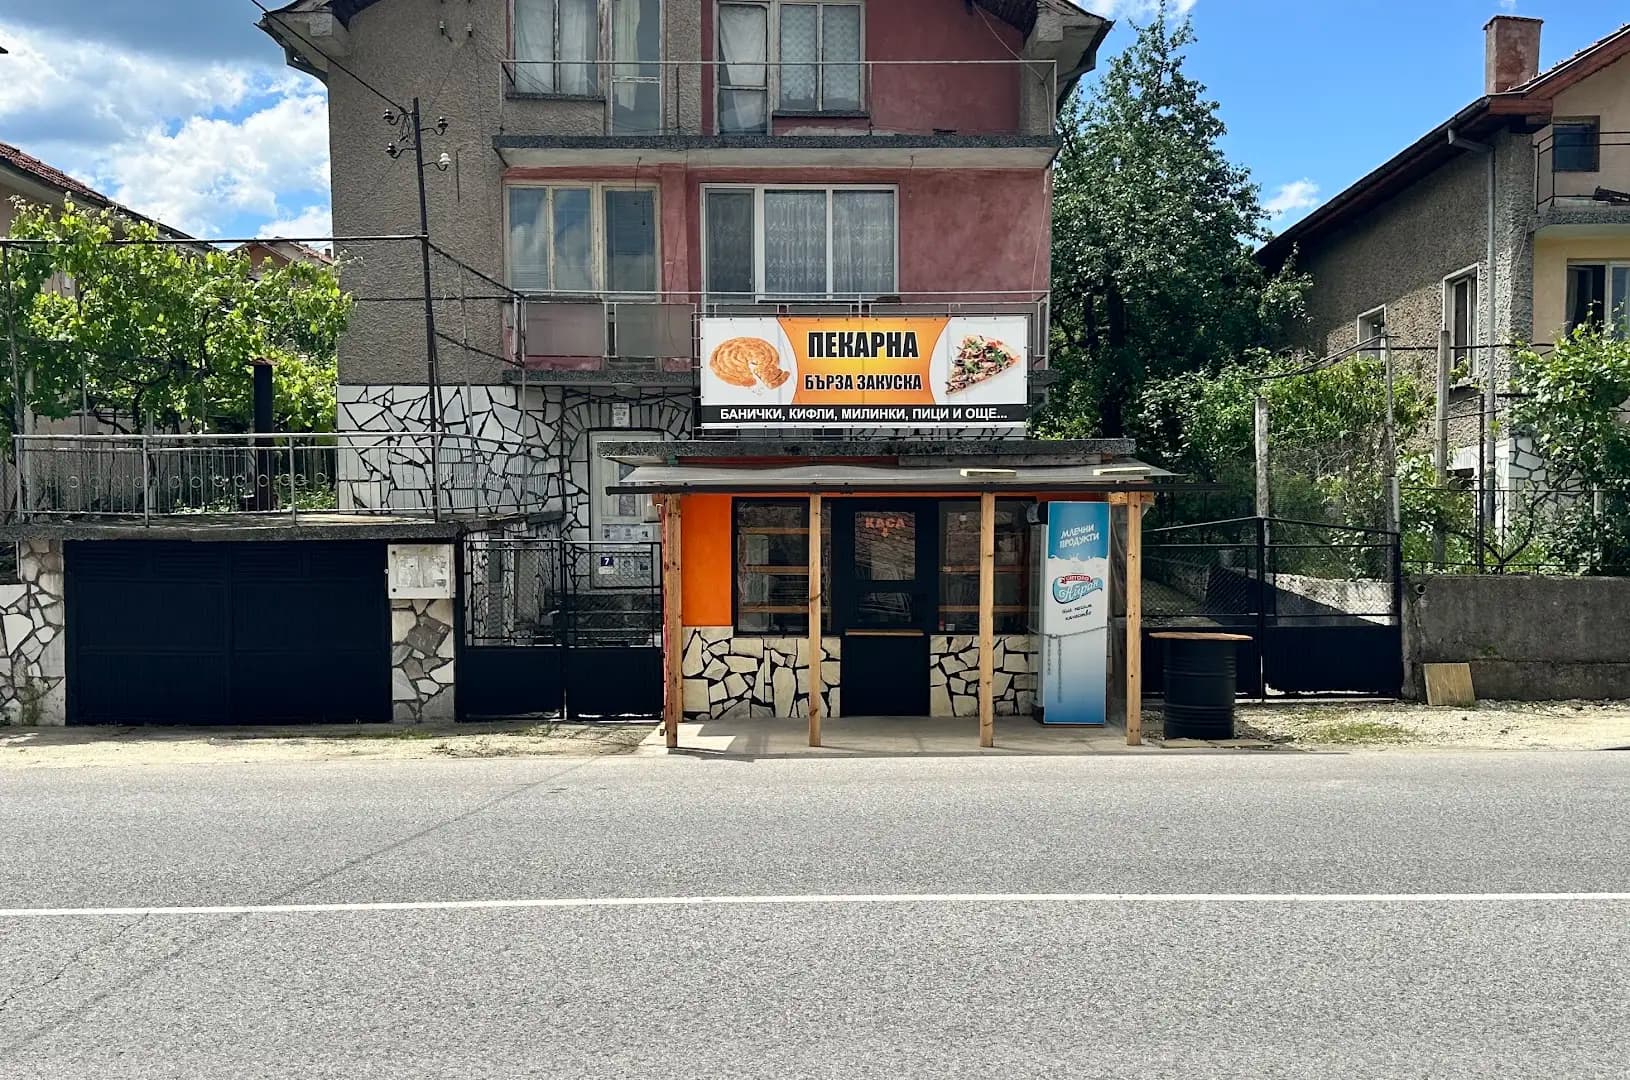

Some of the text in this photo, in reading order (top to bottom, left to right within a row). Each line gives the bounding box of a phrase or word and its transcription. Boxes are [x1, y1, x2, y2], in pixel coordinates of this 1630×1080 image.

[808, 331, 919, 358] ПЕКАРНА
[805, 374, 922, 390] БЪРЗА ЗАКУСКА
[720, 407, 1008, 421] БАНИЧКИ, КИФЛИ, МИЛИНКИ, ПИЦИ И ОЩЕ...
[865, 517, 905, 529] КАСА
[1060, 523, 1095, 541] МЛЕЧНИ
[1059, 531, 1100, 550] ПРОДУКТИ
[604, 557, 610, 566] 7
